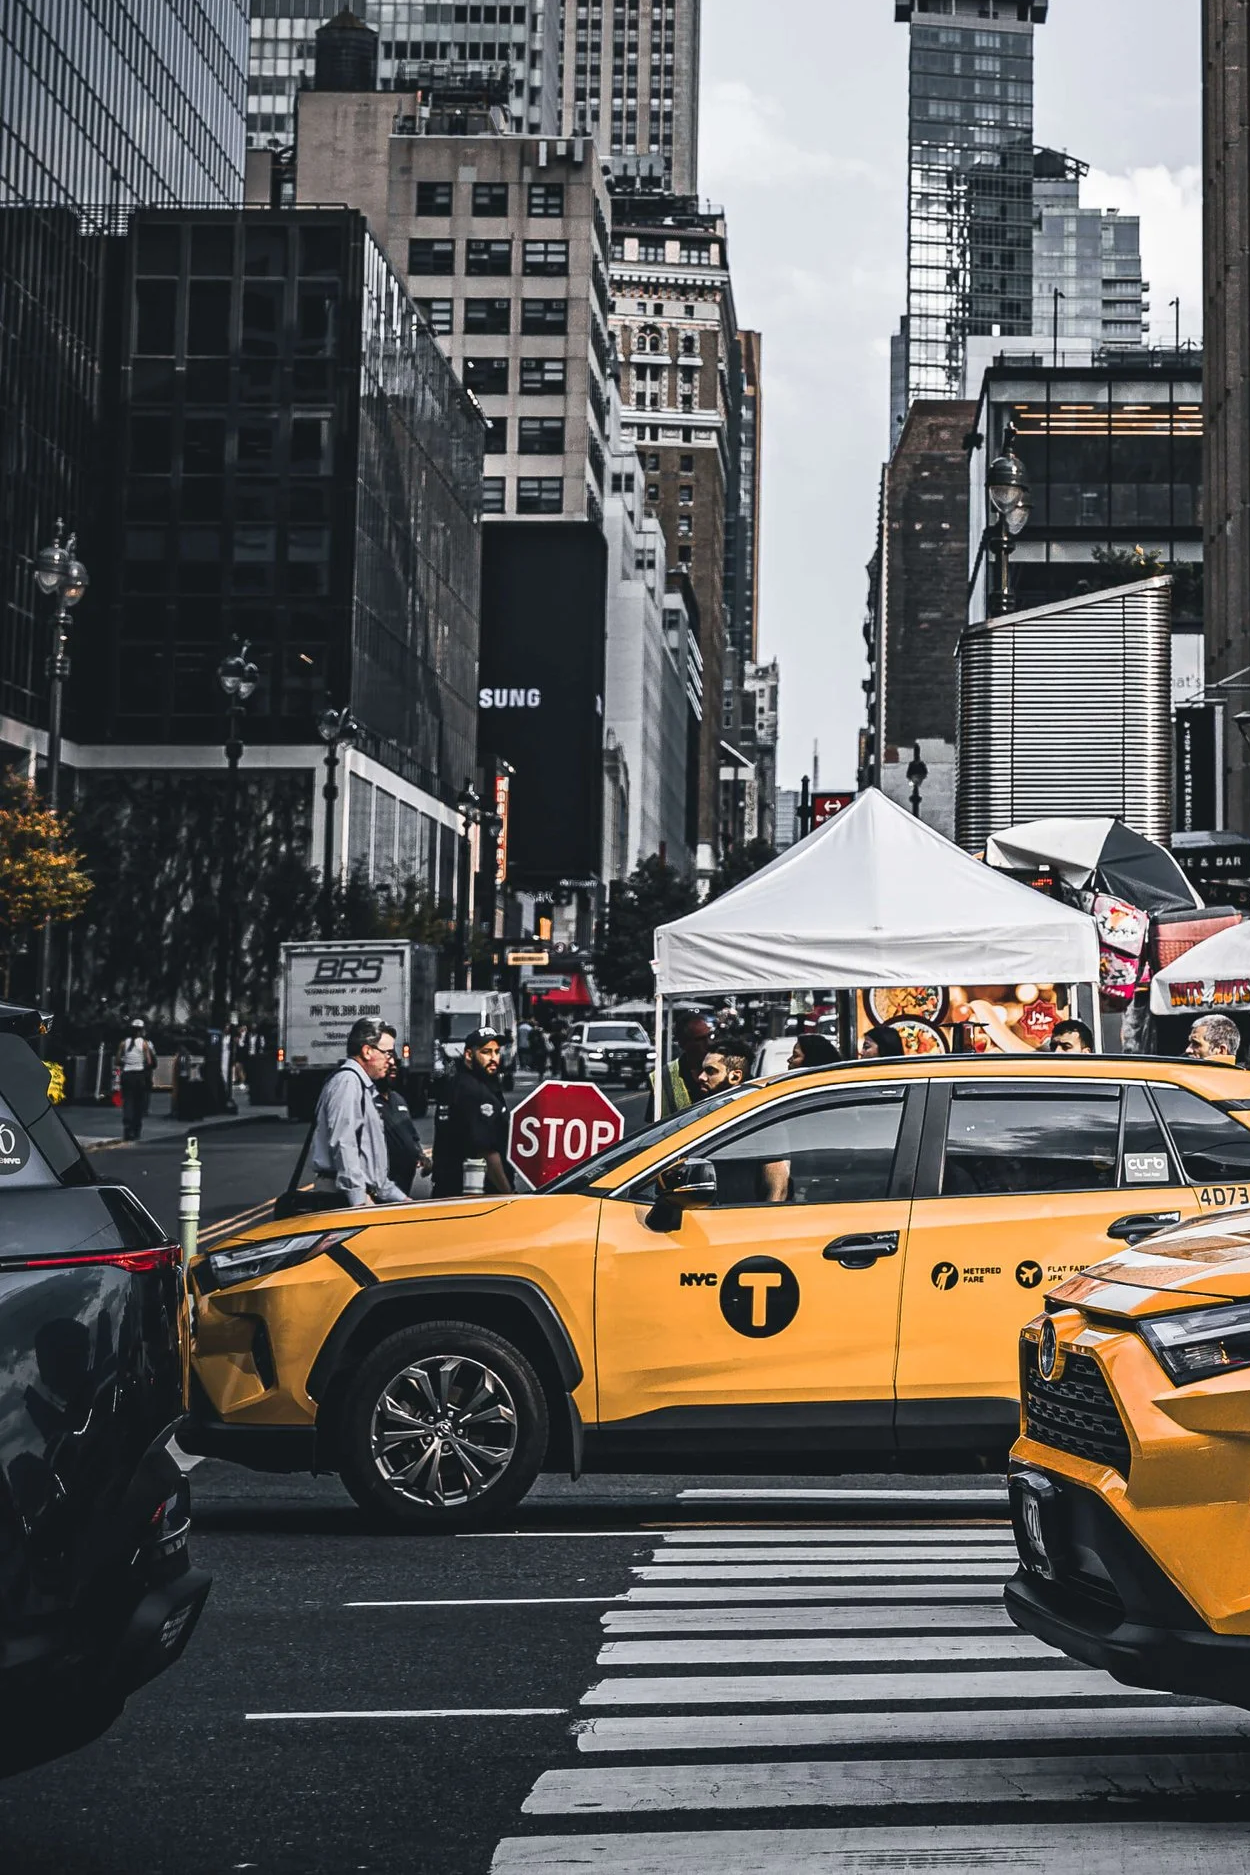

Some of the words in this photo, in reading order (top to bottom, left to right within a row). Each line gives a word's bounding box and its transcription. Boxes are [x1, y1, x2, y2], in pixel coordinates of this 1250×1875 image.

[1173, 674, 1202, 688] at's
[478, 687, 542, 709] SUNG
[1216, 856, 1242, 867] BAR
[314, 957, 384, 982] BRS
[1027, 1010, 1053, 1026] حلال
[517, 1115, 616, 1162] STOP
[1127, 1156, 1165, 1170] curb
[1200, 1187, 1249, 1206] 4D73
[963, 1266, 1001, 1275] METERED
[1047, 1265, 1067, 1273] FLAT
[680, 1271, 718, 1287] NYC
[963, 1275, 985, 1284] FARE
[1047, 1274, 1063, 1282] JFK
[737, 1272, 782, 1327] T
